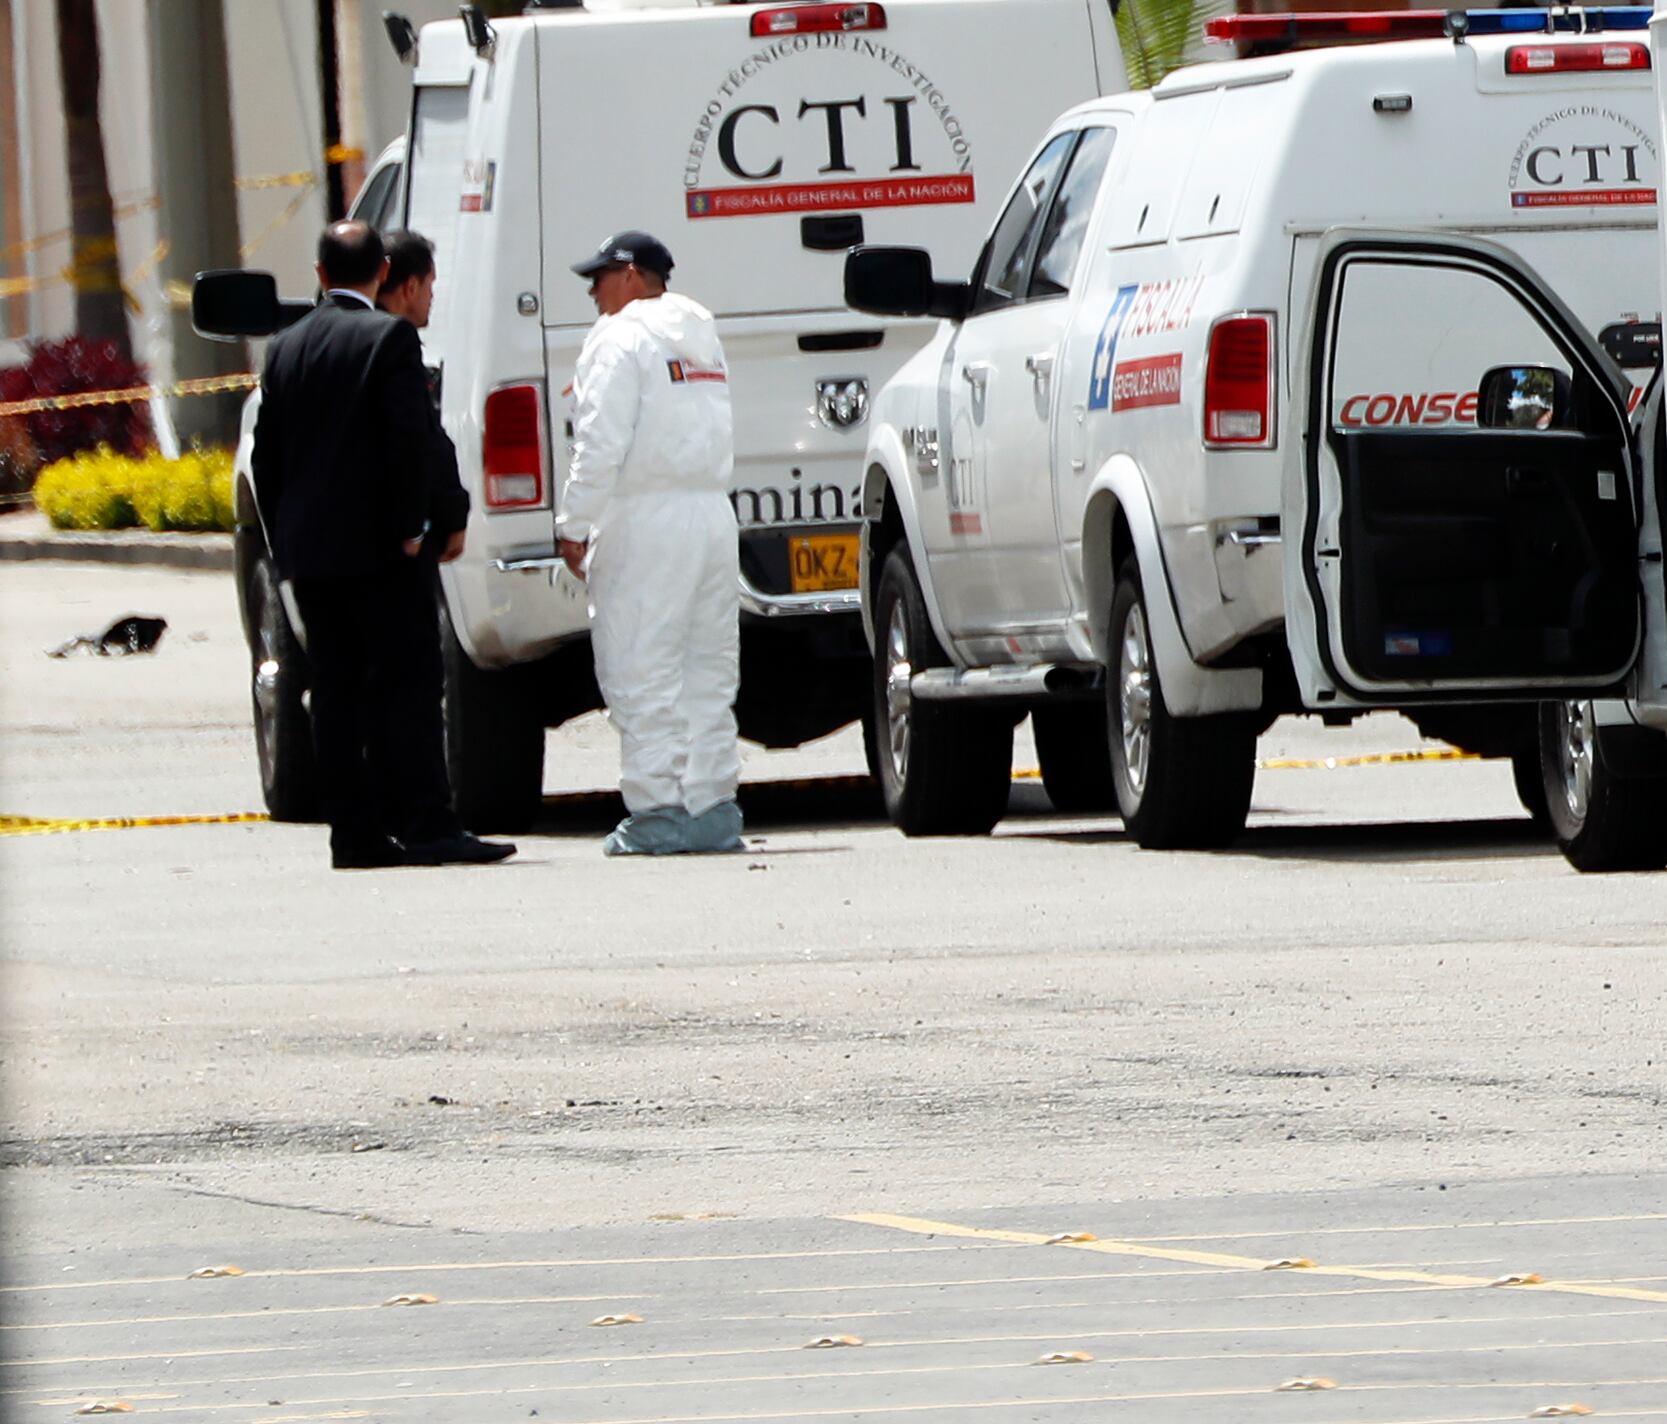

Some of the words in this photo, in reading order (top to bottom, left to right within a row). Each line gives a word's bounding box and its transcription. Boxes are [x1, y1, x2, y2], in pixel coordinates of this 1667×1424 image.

[684, 99, 722, 190] CUERPO
[716, 32, 809, 98] TÉCNICO
[815, 30, 847, 51] DE
[852, 36, 974, 173] INVESTIGACIÓN
[1581, 105, 1599, 116] DE
[717, 94, 922, 182] CTI
[1526, 143, 1642, 186] CTI
[787, 188, 860, 207] GENERAL
[863, 187, 883, 200] DE
[887, 186, 908, 199] LA
[1339, 392, 1480, 426] CONSE
